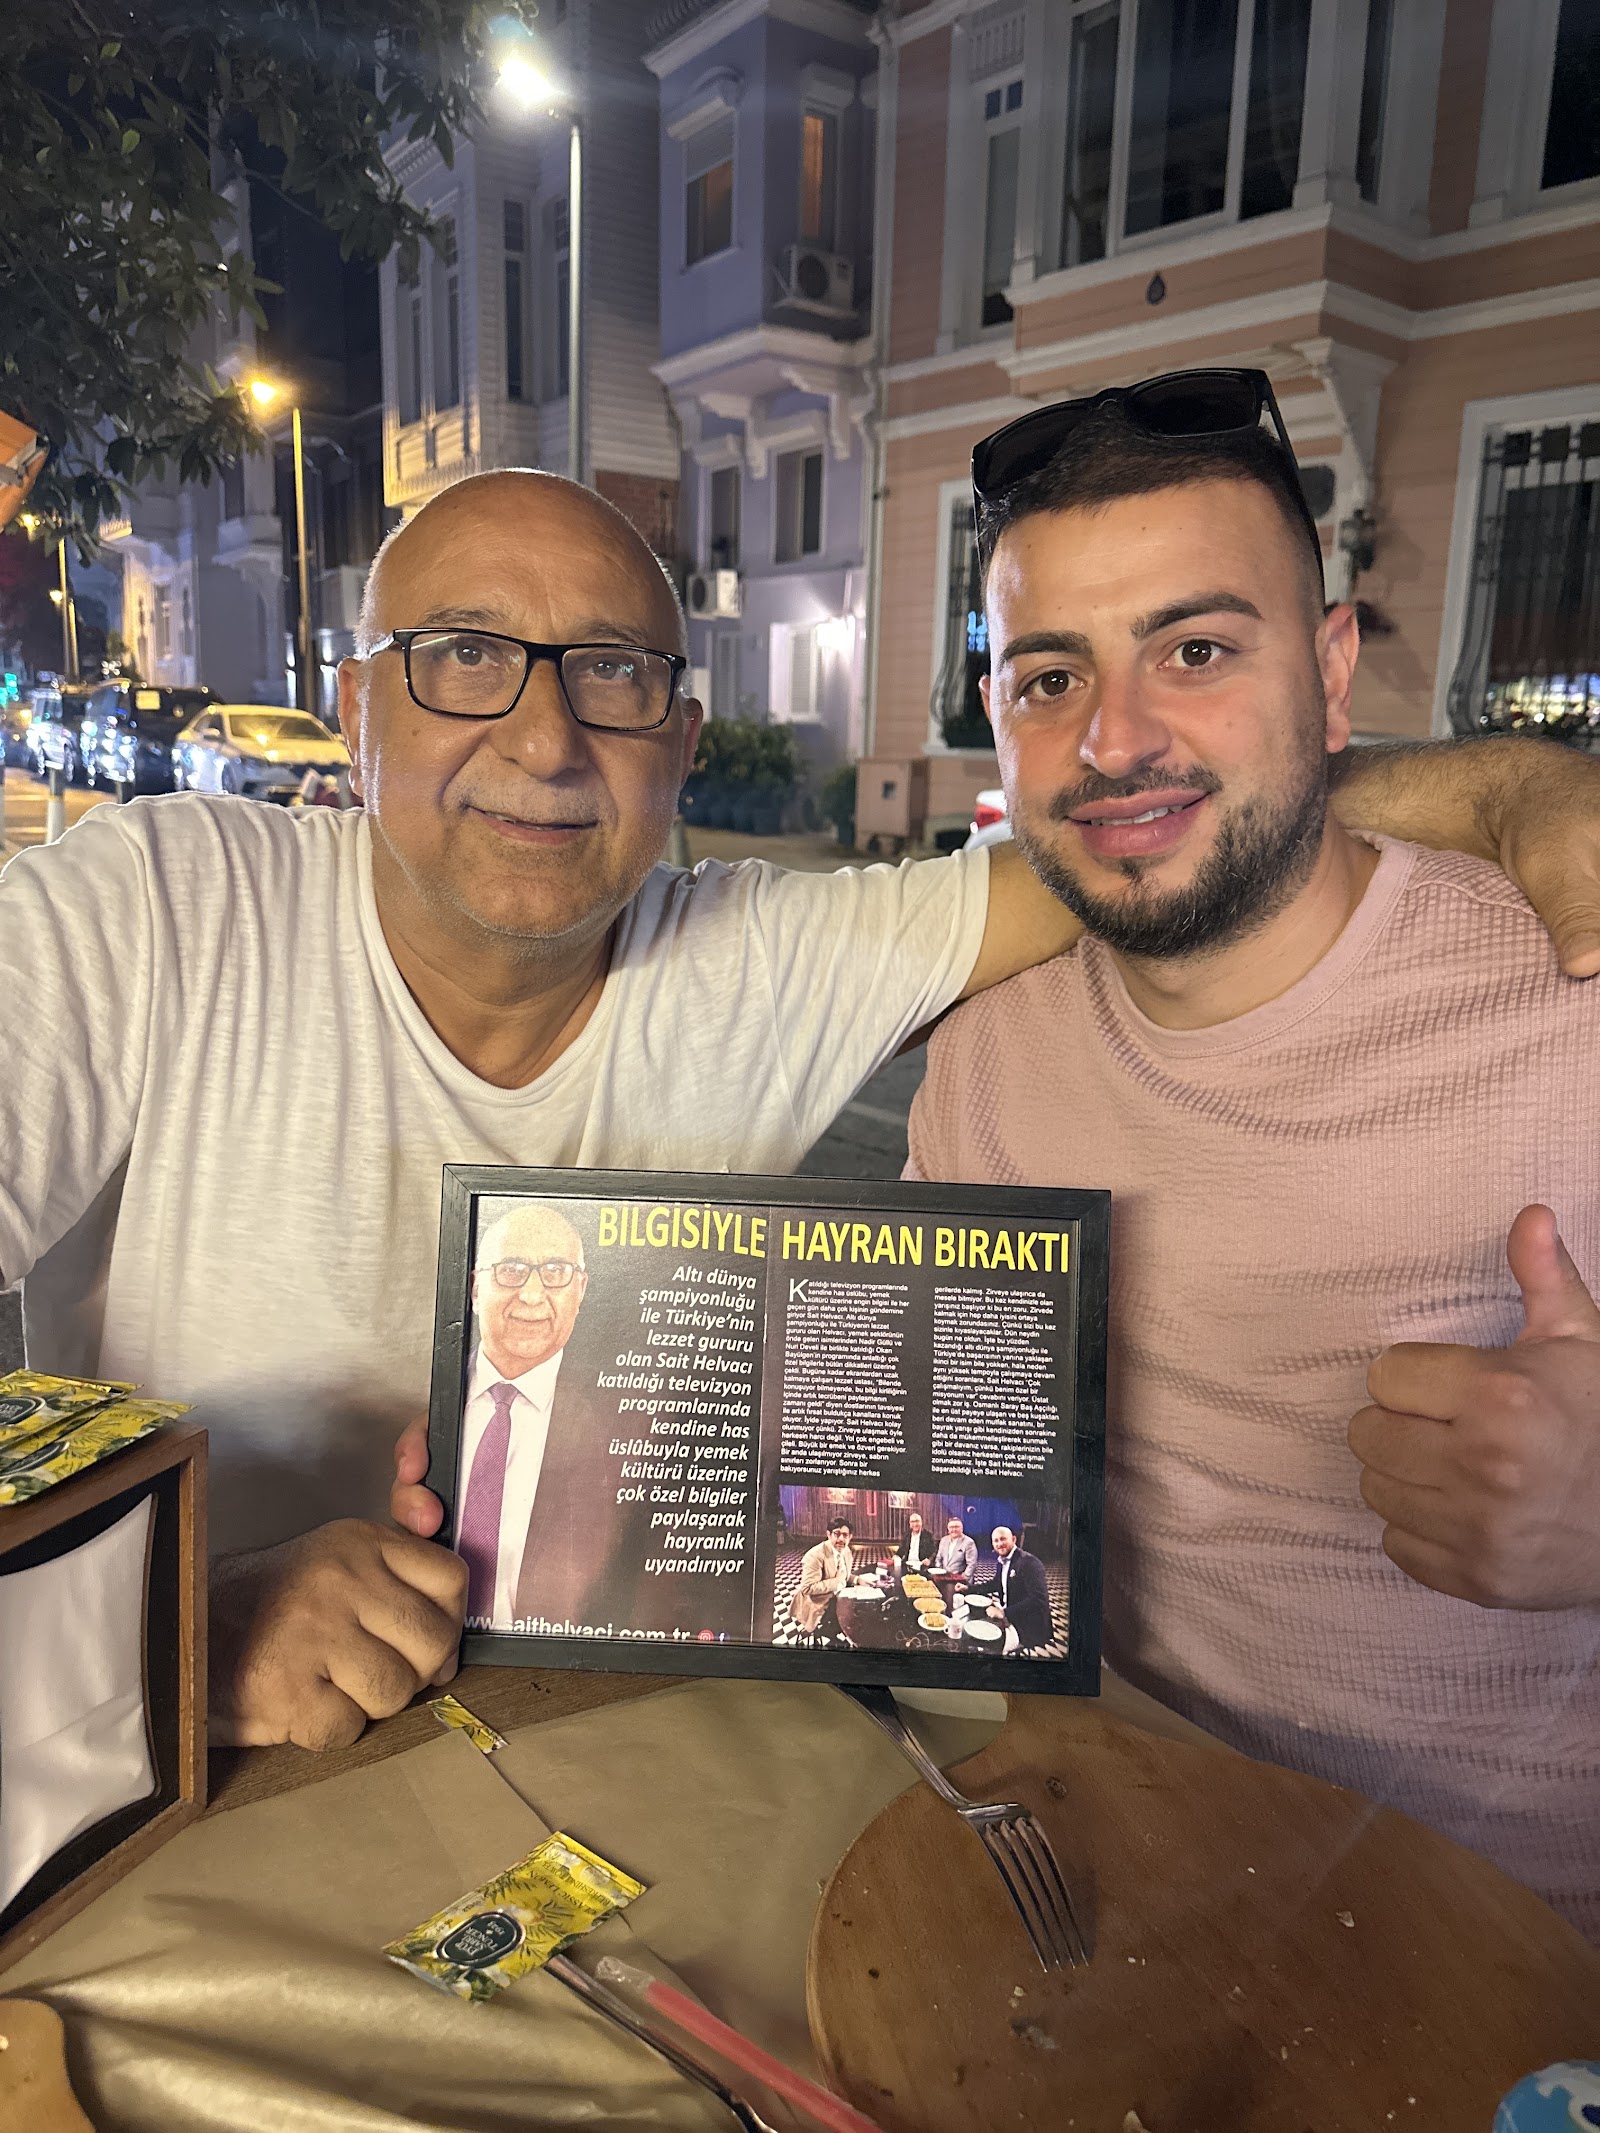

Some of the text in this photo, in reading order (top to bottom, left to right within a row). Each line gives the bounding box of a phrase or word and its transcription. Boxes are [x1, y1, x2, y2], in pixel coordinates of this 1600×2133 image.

[599, 1203, 1070, 1273] BİLGİSİYLE HAYRAN BIRAKTI
[672, 1265, 757, 1291] Altı dünya
[638, 1288, 756, 1312] şampiyonluğu
[640, 1307, 660, 1324] ile
[646, 1329, 754, 1353] lezzet gururu
[615, 1350, 753, 1374] olan Sait Helvacı
[596, 1371, 752, 1397] katıldığı televizyon
[617, 1397, 751, 1417] programlarında
[650, 1418, 750, 1438] kendine has
[608, 1438, 750, 1462] üslûbuyla yemek
[620, 1461, 748, 1482] kültürü üzerine
[616, 1484, 748, 1508] çok özel bilgiler
[650, 1508, 747, 1530] paylaşarak
[663, 1531, 746, 1553] hayranlık
[644, 1555, 745, 1577] uyandırıyor
[465, 1927, 498, 1951] TUNCER
